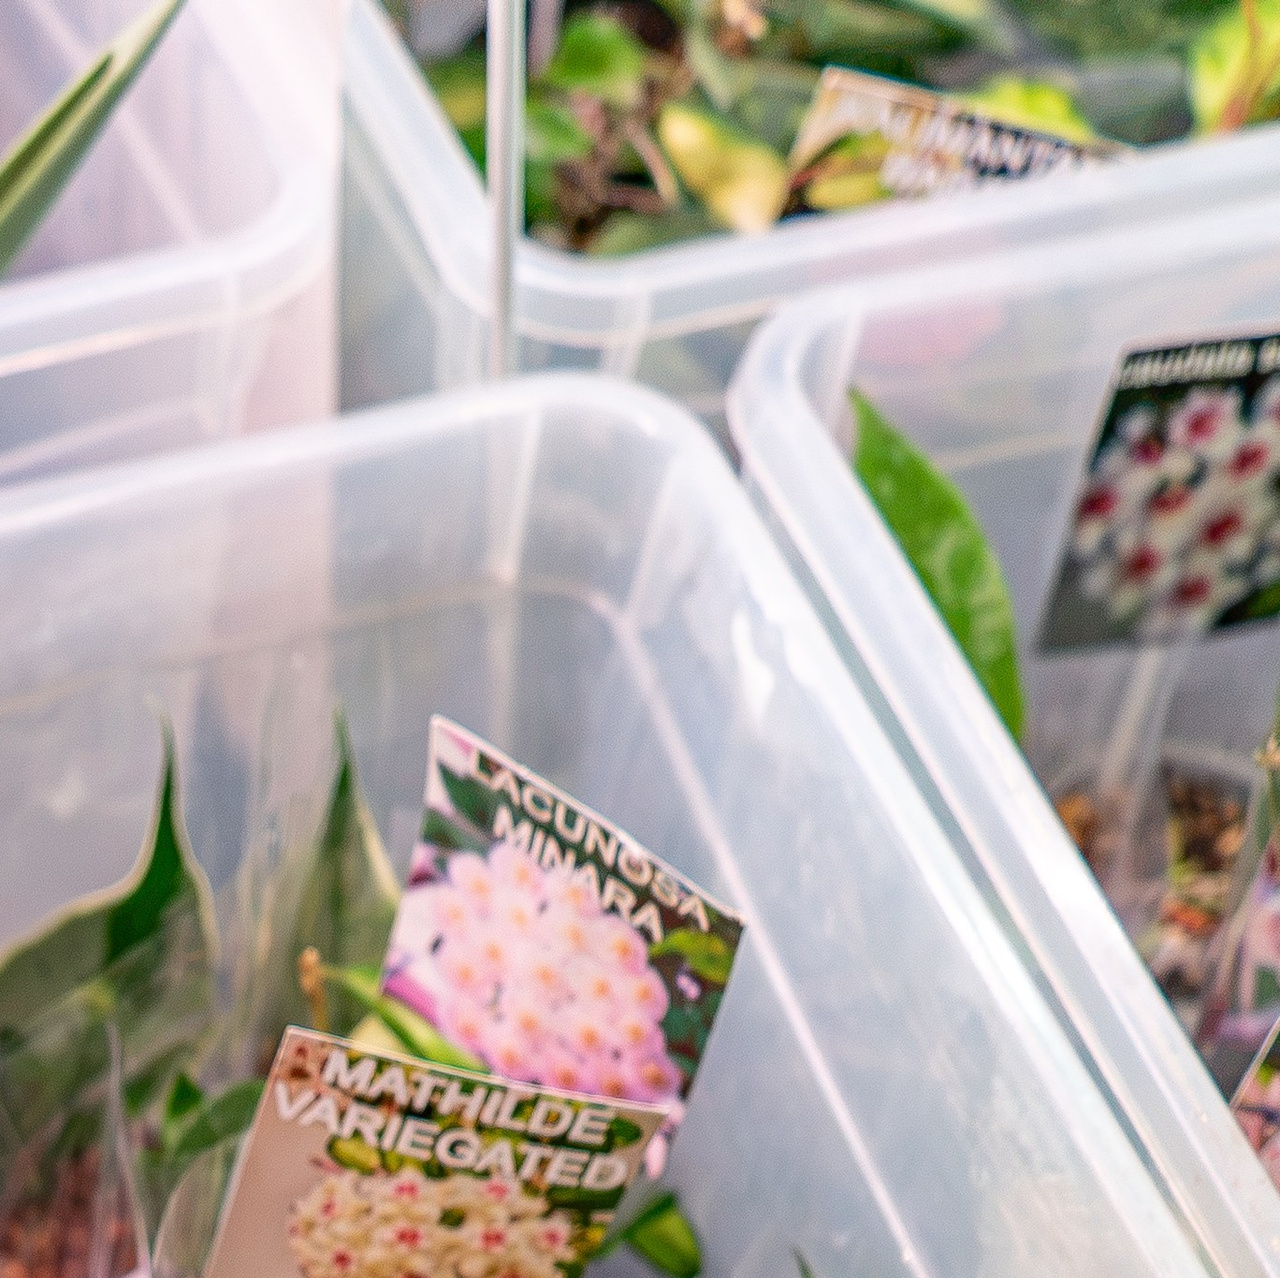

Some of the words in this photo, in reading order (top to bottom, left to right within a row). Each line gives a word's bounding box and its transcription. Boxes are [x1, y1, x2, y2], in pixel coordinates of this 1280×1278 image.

[473, 748, 710, 932] LACUNOSA
[273, 1082, 628, 1193] VARIEGATED
[321, 1049, 614, 1148] MATHILDE
